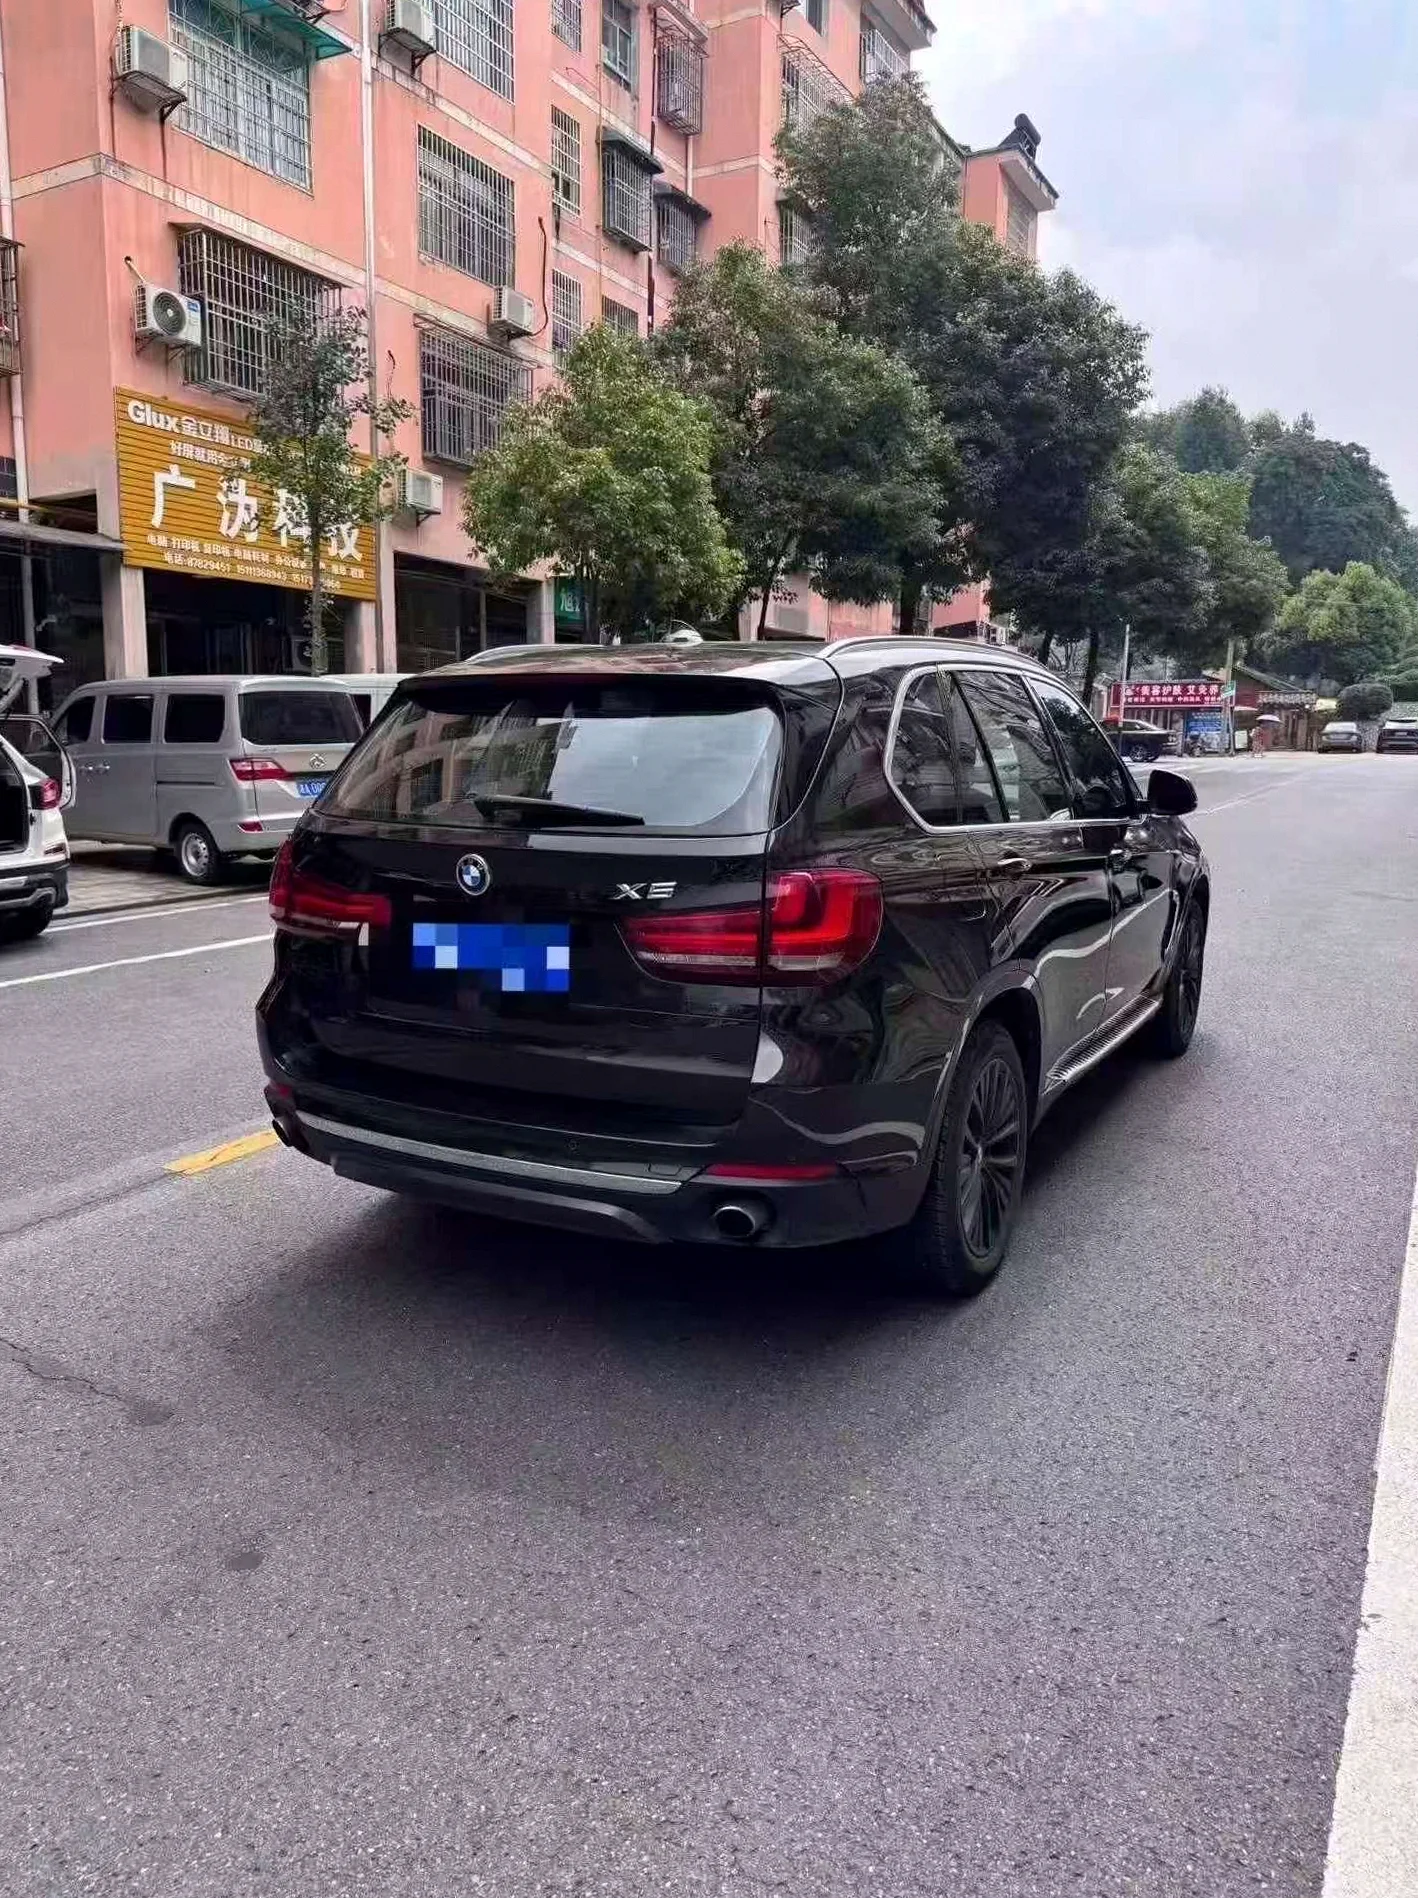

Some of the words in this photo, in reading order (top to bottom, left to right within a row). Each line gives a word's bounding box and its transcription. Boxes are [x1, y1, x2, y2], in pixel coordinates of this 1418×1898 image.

[127, 399, 180, 433] Glux
[1187, 684, 1222, 696] 艾灸养
[612, 881, 678, 900] X5
